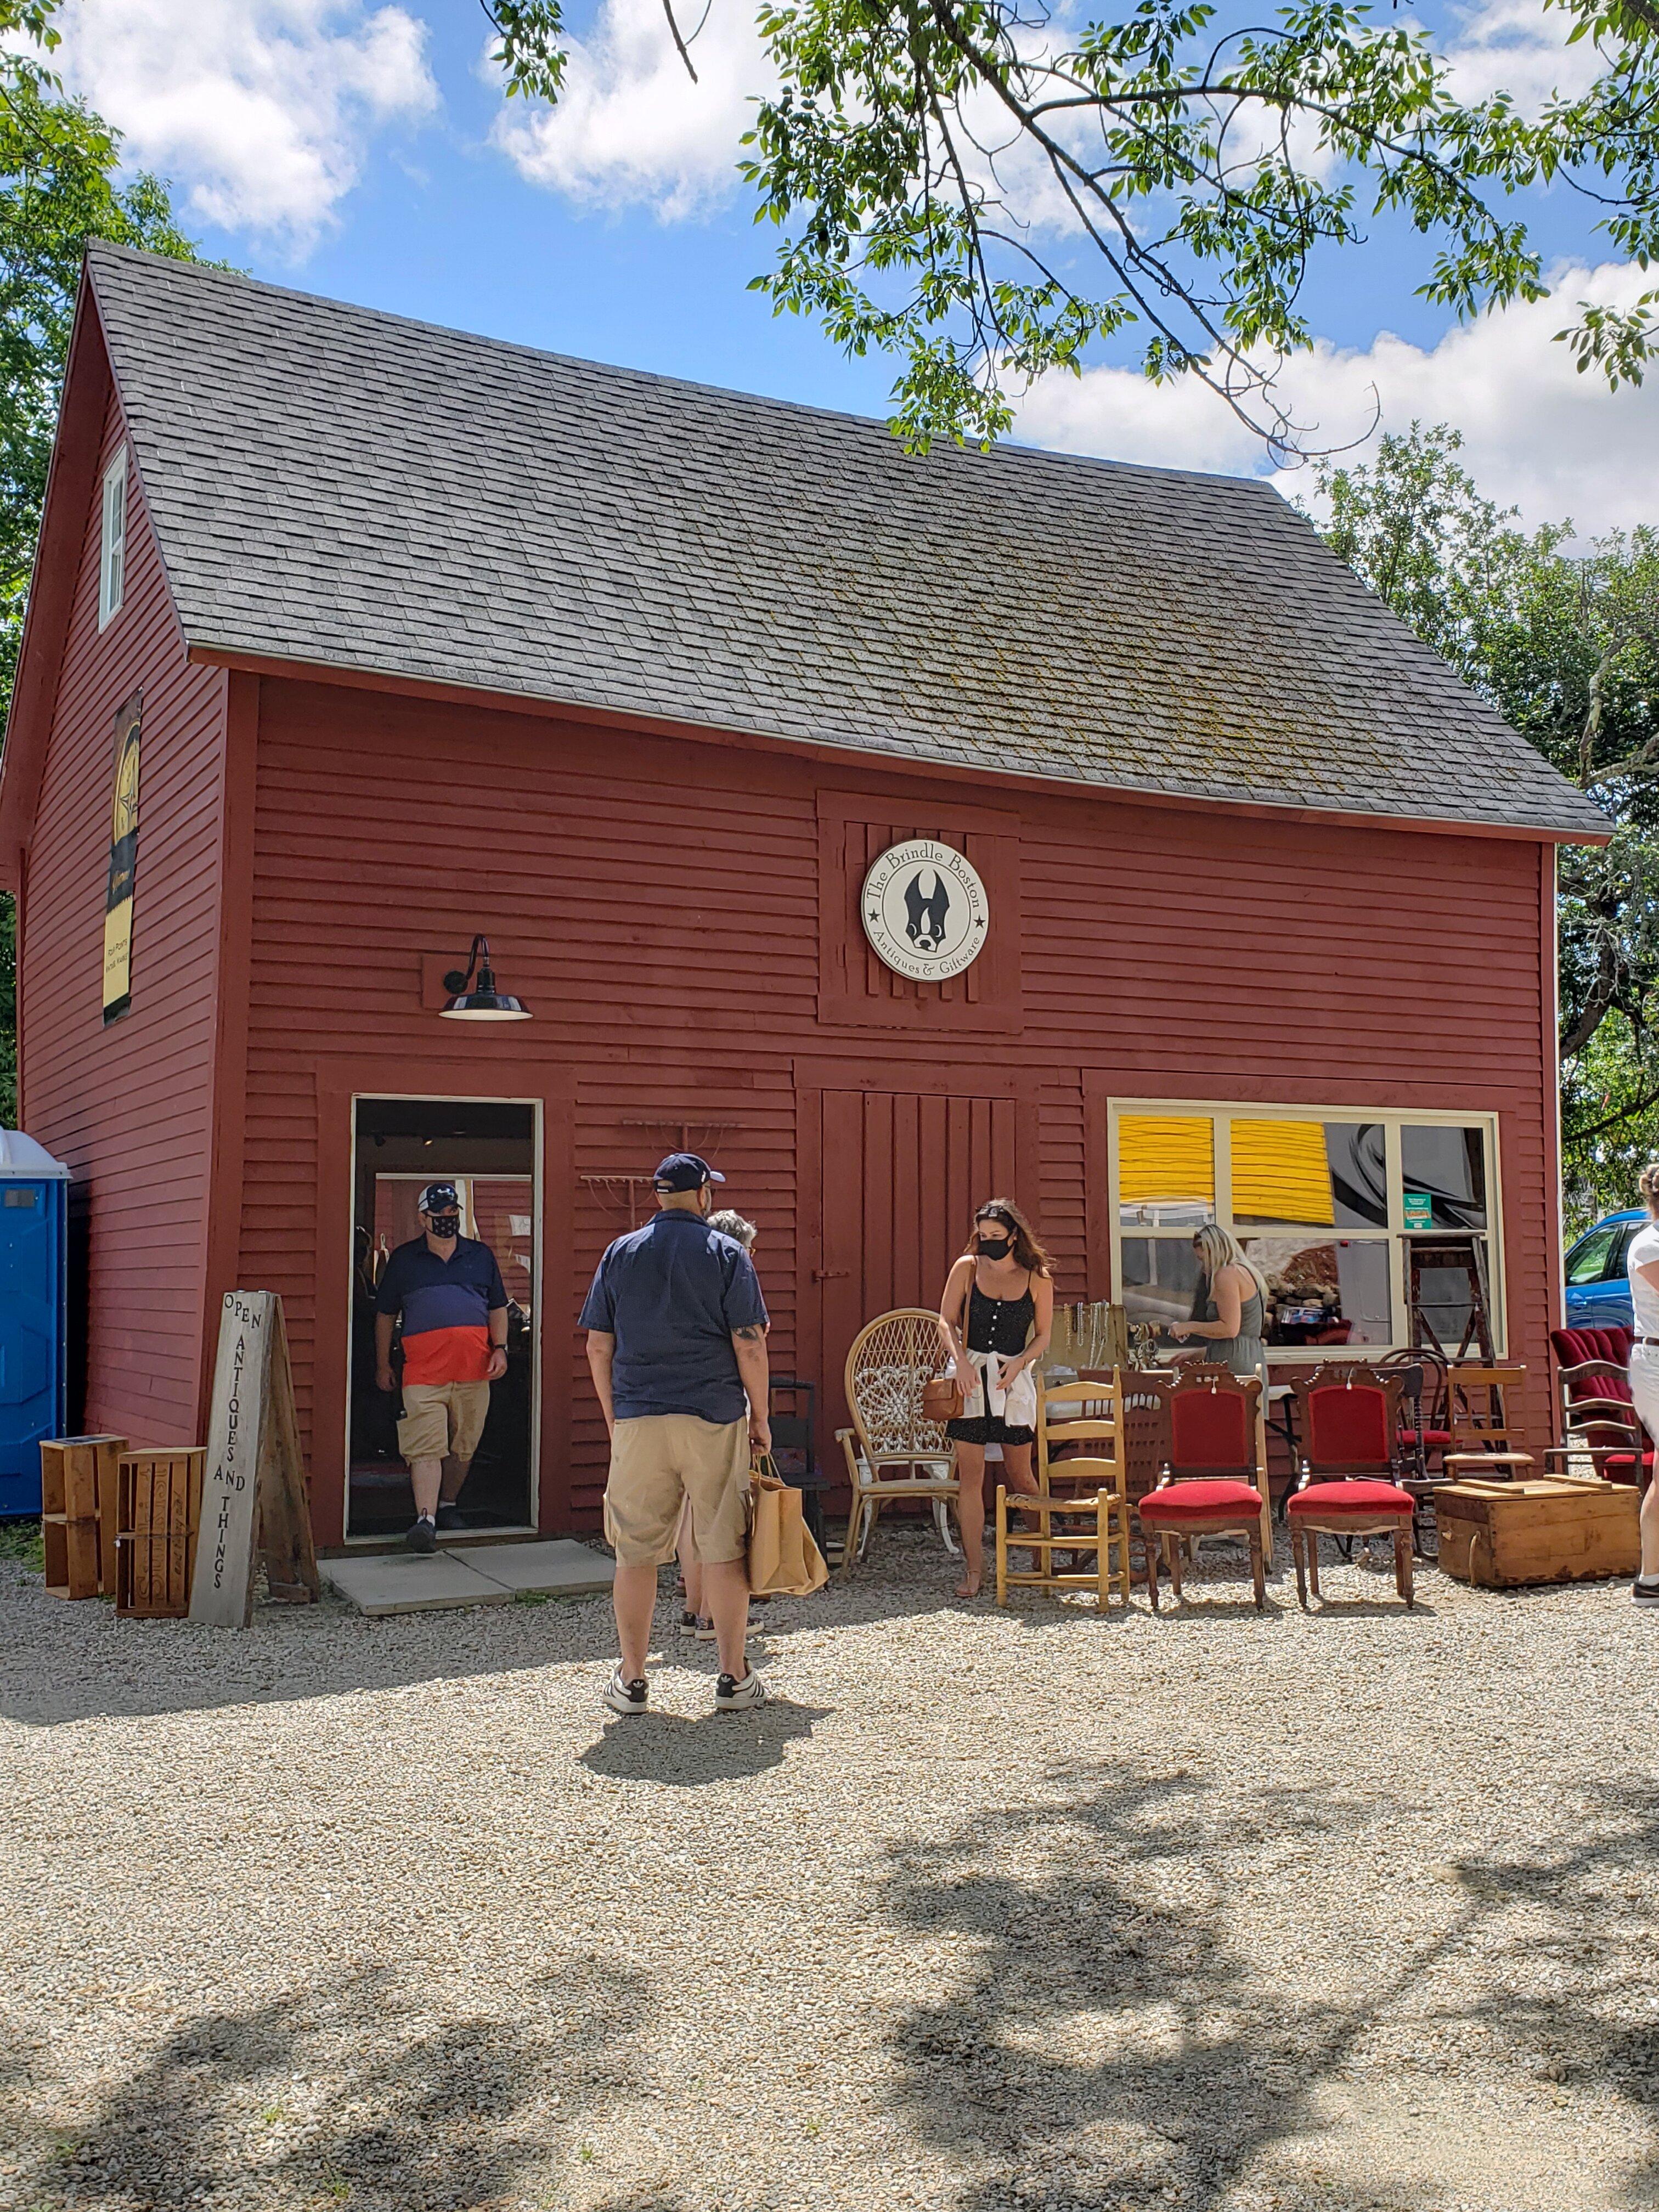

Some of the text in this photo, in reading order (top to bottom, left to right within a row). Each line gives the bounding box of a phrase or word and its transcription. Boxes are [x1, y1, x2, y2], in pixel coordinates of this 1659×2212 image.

[866, 842, 980, 909] The Brindle Boston
[873, 930, 980, 975] Antiques & Giftware
[224, 1294, 262, 1329] OPEN
[227, 1335, 245, 1462] ANTIQUES
[213, 1464, 245, 1491] AND
[214, 1496, 230, 1589] THINGS
